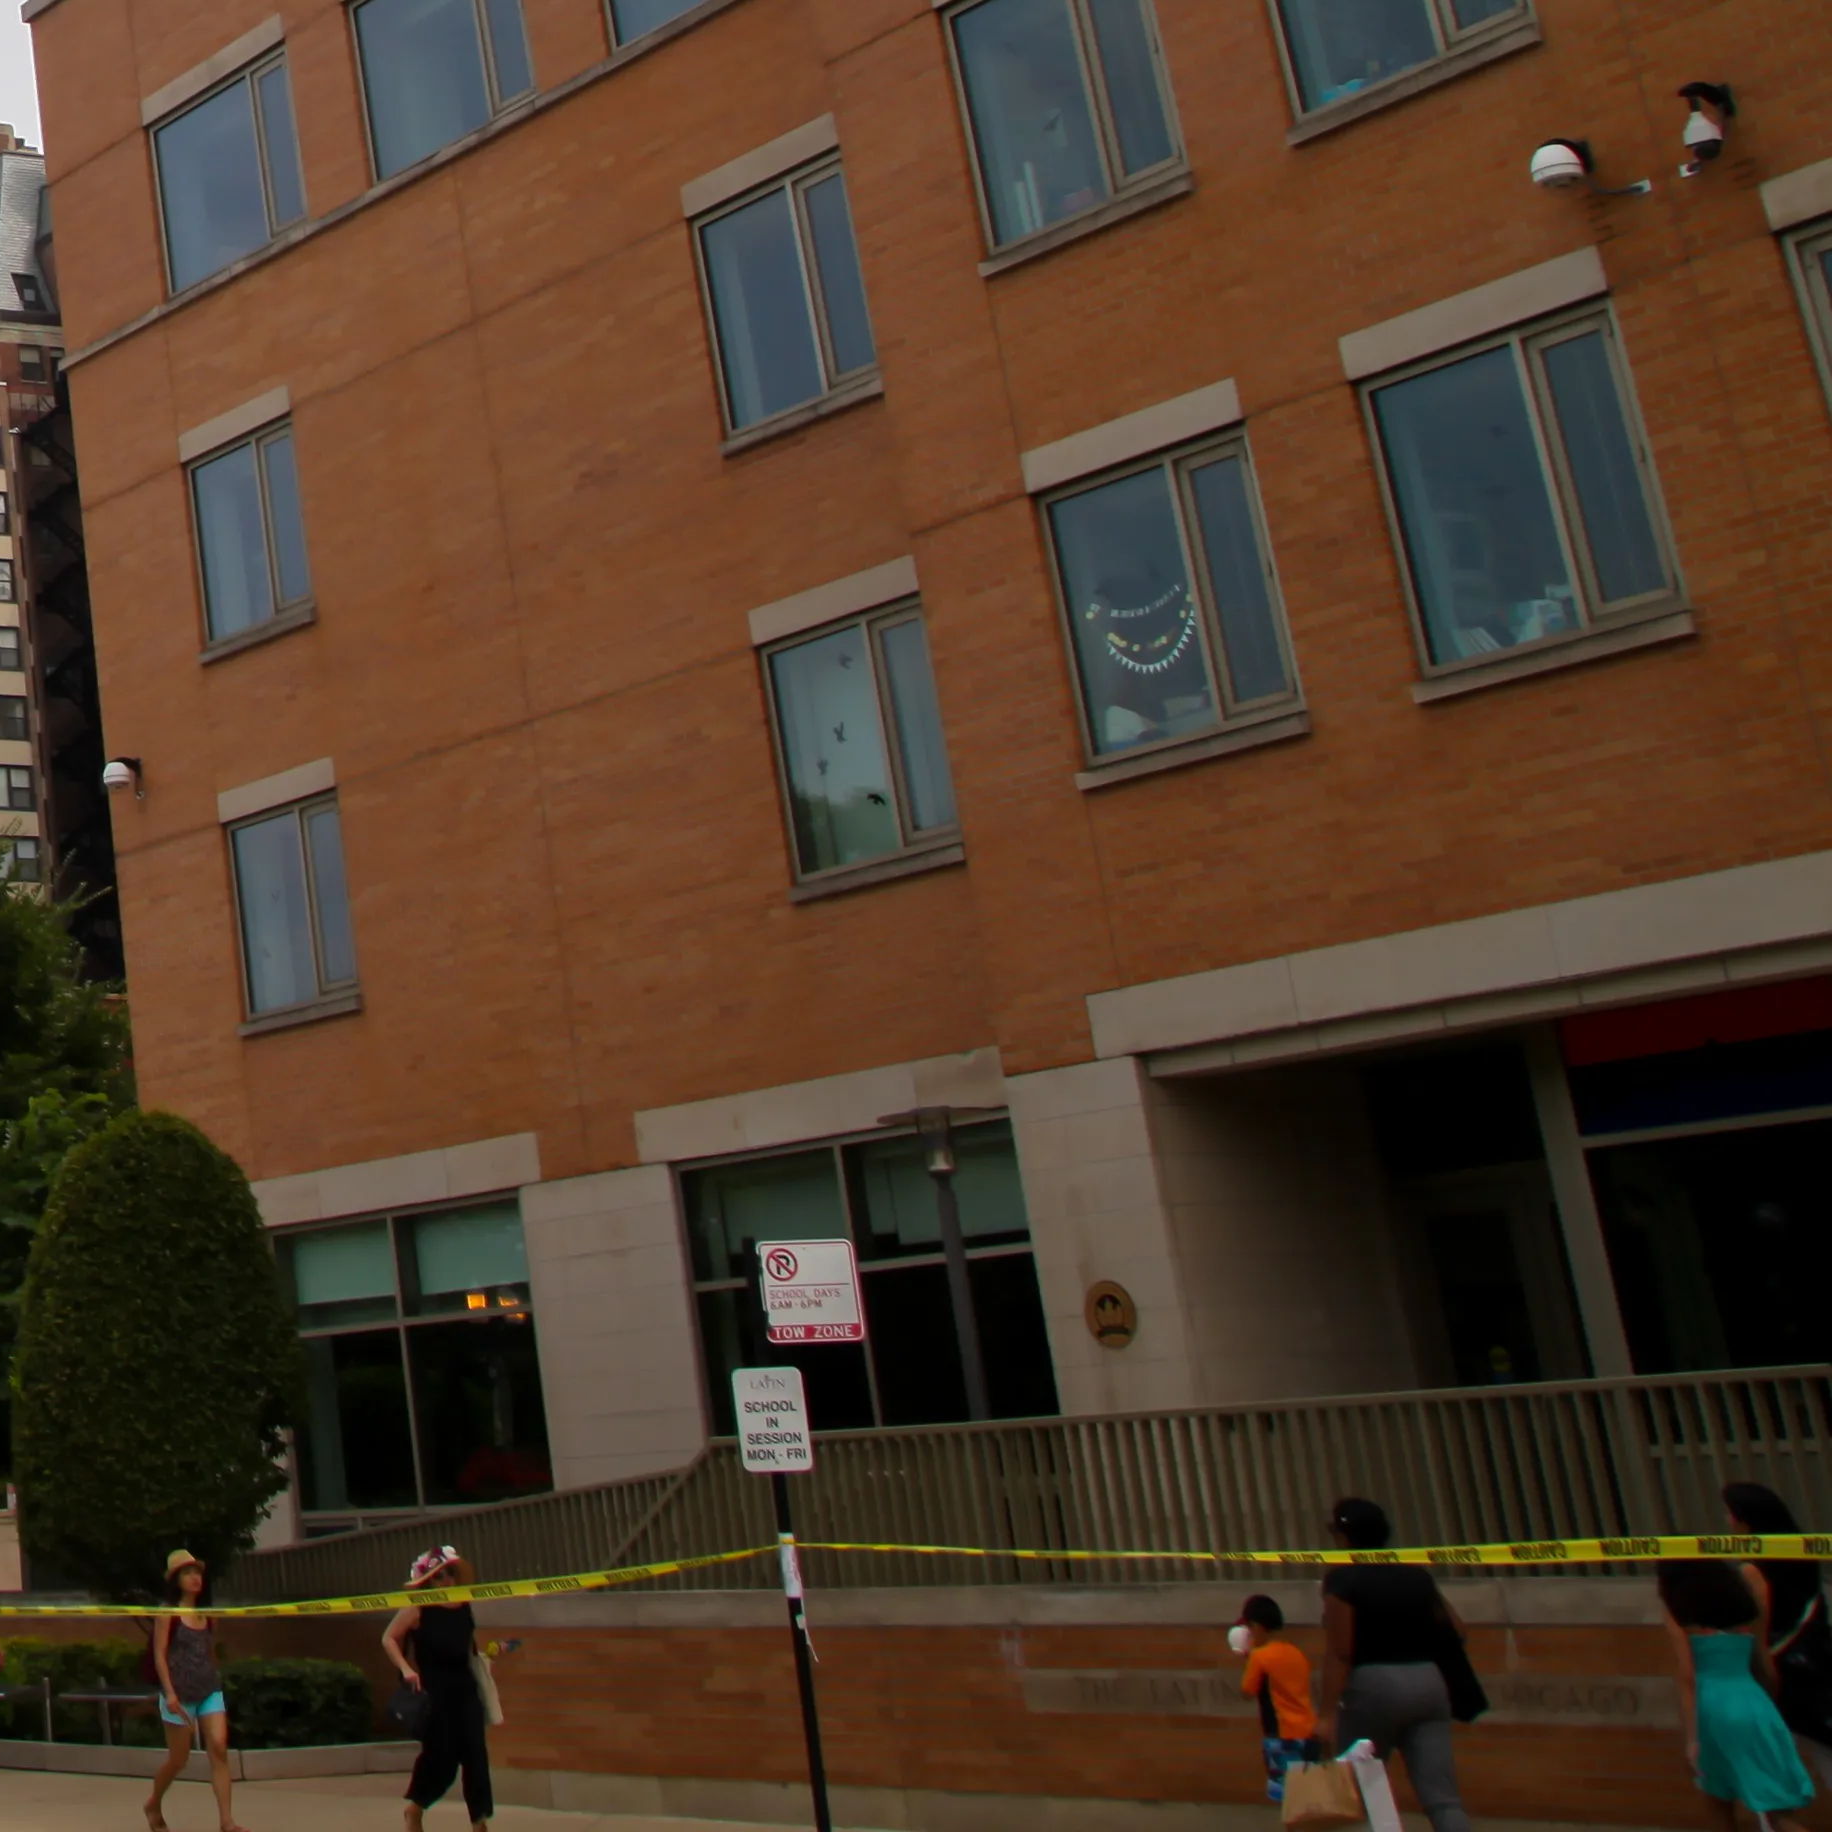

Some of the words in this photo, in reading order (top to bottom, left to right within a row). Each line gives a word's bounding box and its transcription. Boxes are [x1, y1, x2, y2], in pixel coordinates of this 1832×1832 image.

[769, 1289, 809, 1300] SCHOOL
[814, 1288, 841, 1299] DAYS
[775, 1326, 805, 1339] TOW
[813, 1325, 854, 1338] ZONE
[744, 1400, 798, 1414] SCHOOL
[765, 1417, 779, 1429] IN
[747, 1432, 803, 1446] SESSION
[747, 1449, 776, 1461] MON
[786, 1448, 807, 1460] FRI
[1599, 1537, 1661, 1556] CAUTION
[1697, 1536, 1763, 1554] CAUTION
[1490, 1683, 1639, 1715] HICAGO
